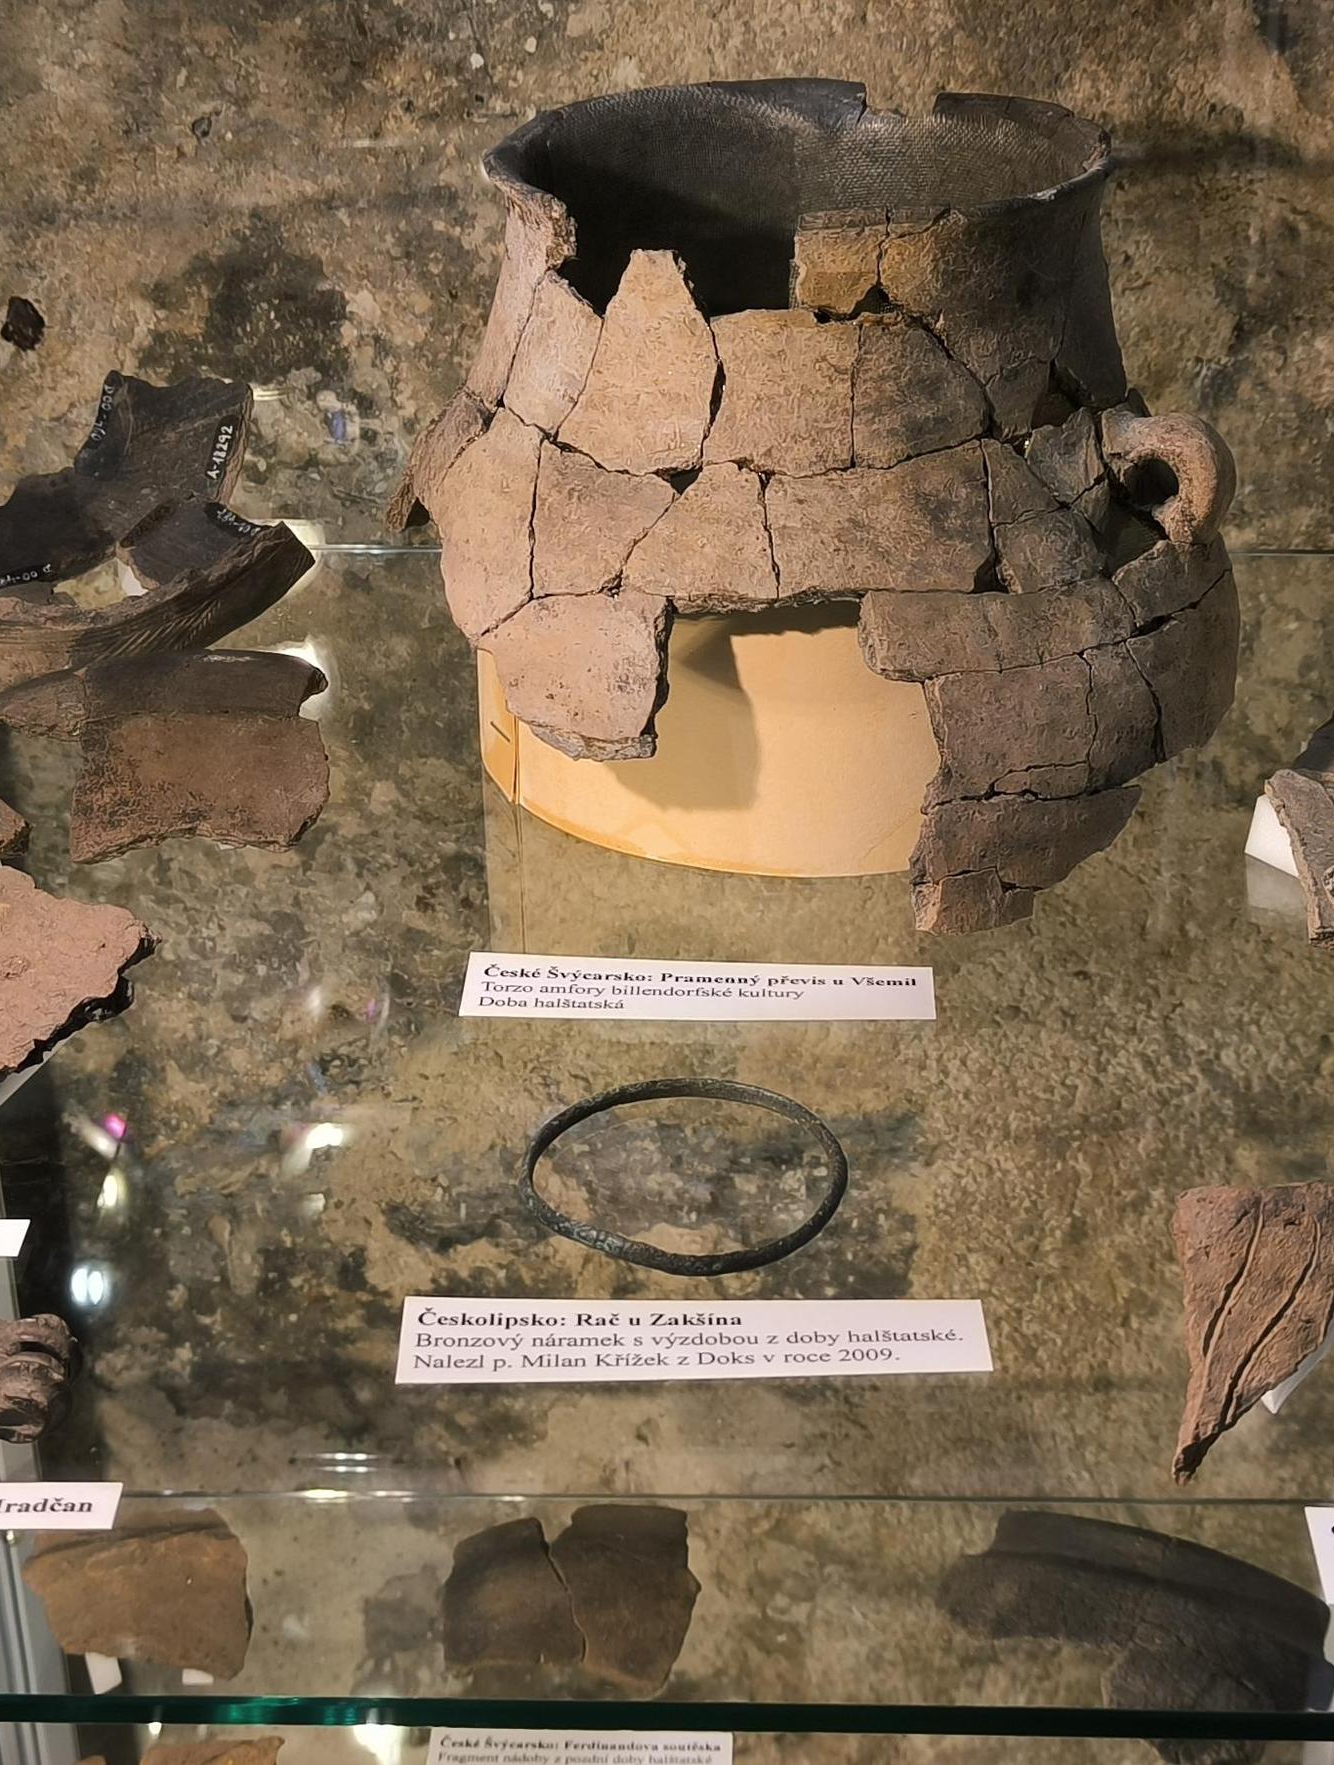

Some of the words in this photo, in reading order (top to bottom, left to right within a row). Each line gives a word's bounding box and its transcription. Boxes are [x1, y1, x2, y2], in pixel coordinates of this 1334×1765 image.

[483, 963, 541, 979] České
[546, 965, 653, 983] Švýcarsko:
[660, 972, 759, 987] Pramenný
[767, 975, 826, 987] převis
[851, 976, 917, 987] Všemil
[481, 981, 534, 993] Torzo
[539, 983, 606, 998] amfory
[611, 985, 733, 998] billendorfské
[738, 987, 805, 1001] kultury
[478, 996, 528, 1008] Doba
[534, 997, 625, 1010] halštatská
[417, 1307, 566, 1330] Českolipsko:
[576, 1313, 620, 1327] Rač
[628, 1317, 641, 1327] u
[650, 1312, 742, 1327] Zakšína
[415, 1332, 524, 1351] Bronzový
[531, 1332, 625, 1348] náramek
[632, 1336, 644, 1347] s
[651, 1331, 759, 1350] výzdobou
[766, 1335, 780, 1345] z
[785, 1330, 840, 1347] doby
[847, 1328, 964, 1343] halštatské.
[413, 1354, 484, 1369] Nalezl
[492, 1358, 513, 1373] p.
[521, 1353, 586, 1368] Milan
[595, 1352, 670, 1367] Křížek
[676, 1355, 691, 1366] z
[698, 1351, 756, 1366] Doks
[762, 1353, 776, 1363] v
[783, 1352, 832, 1364] roce
[838, 1347, 900, 1362] 2009.
